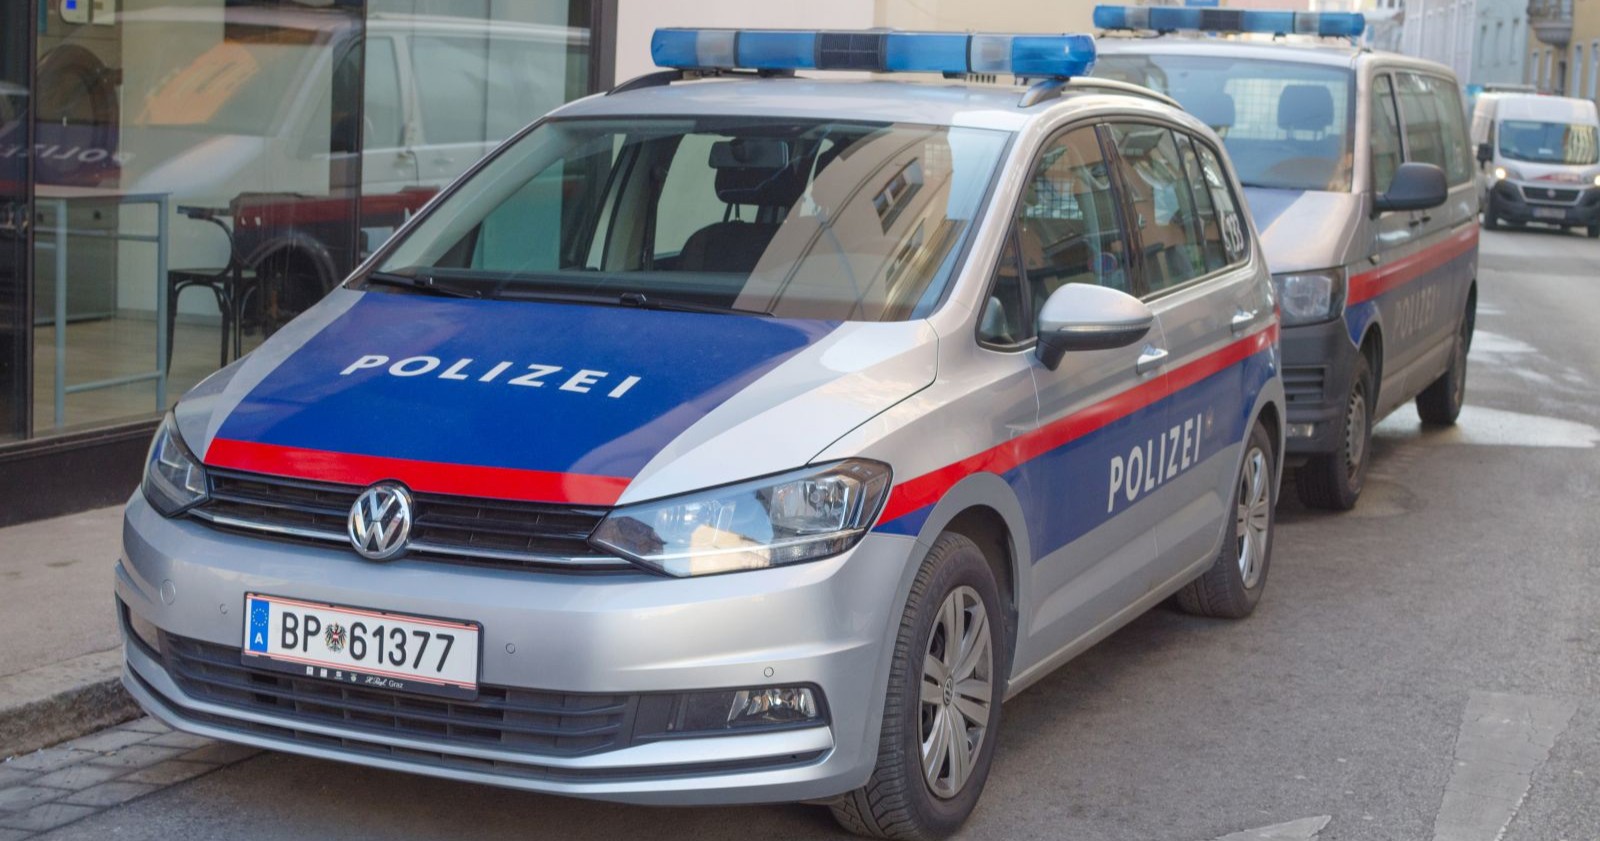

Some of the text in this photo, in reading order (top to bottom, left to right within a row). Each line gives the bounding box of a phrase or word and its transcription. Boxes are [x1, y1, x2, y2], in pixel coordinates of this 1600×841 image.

[339, 354, 642, 399] POLIZEI
[1107, 412, 1203, 514] POLIZEI
[349, 486, 410, 559] VW
[254, 632, 264, 645] A
[281, 611, 455, 673] BP 61377
[388, 679, 404, 689] Graz
